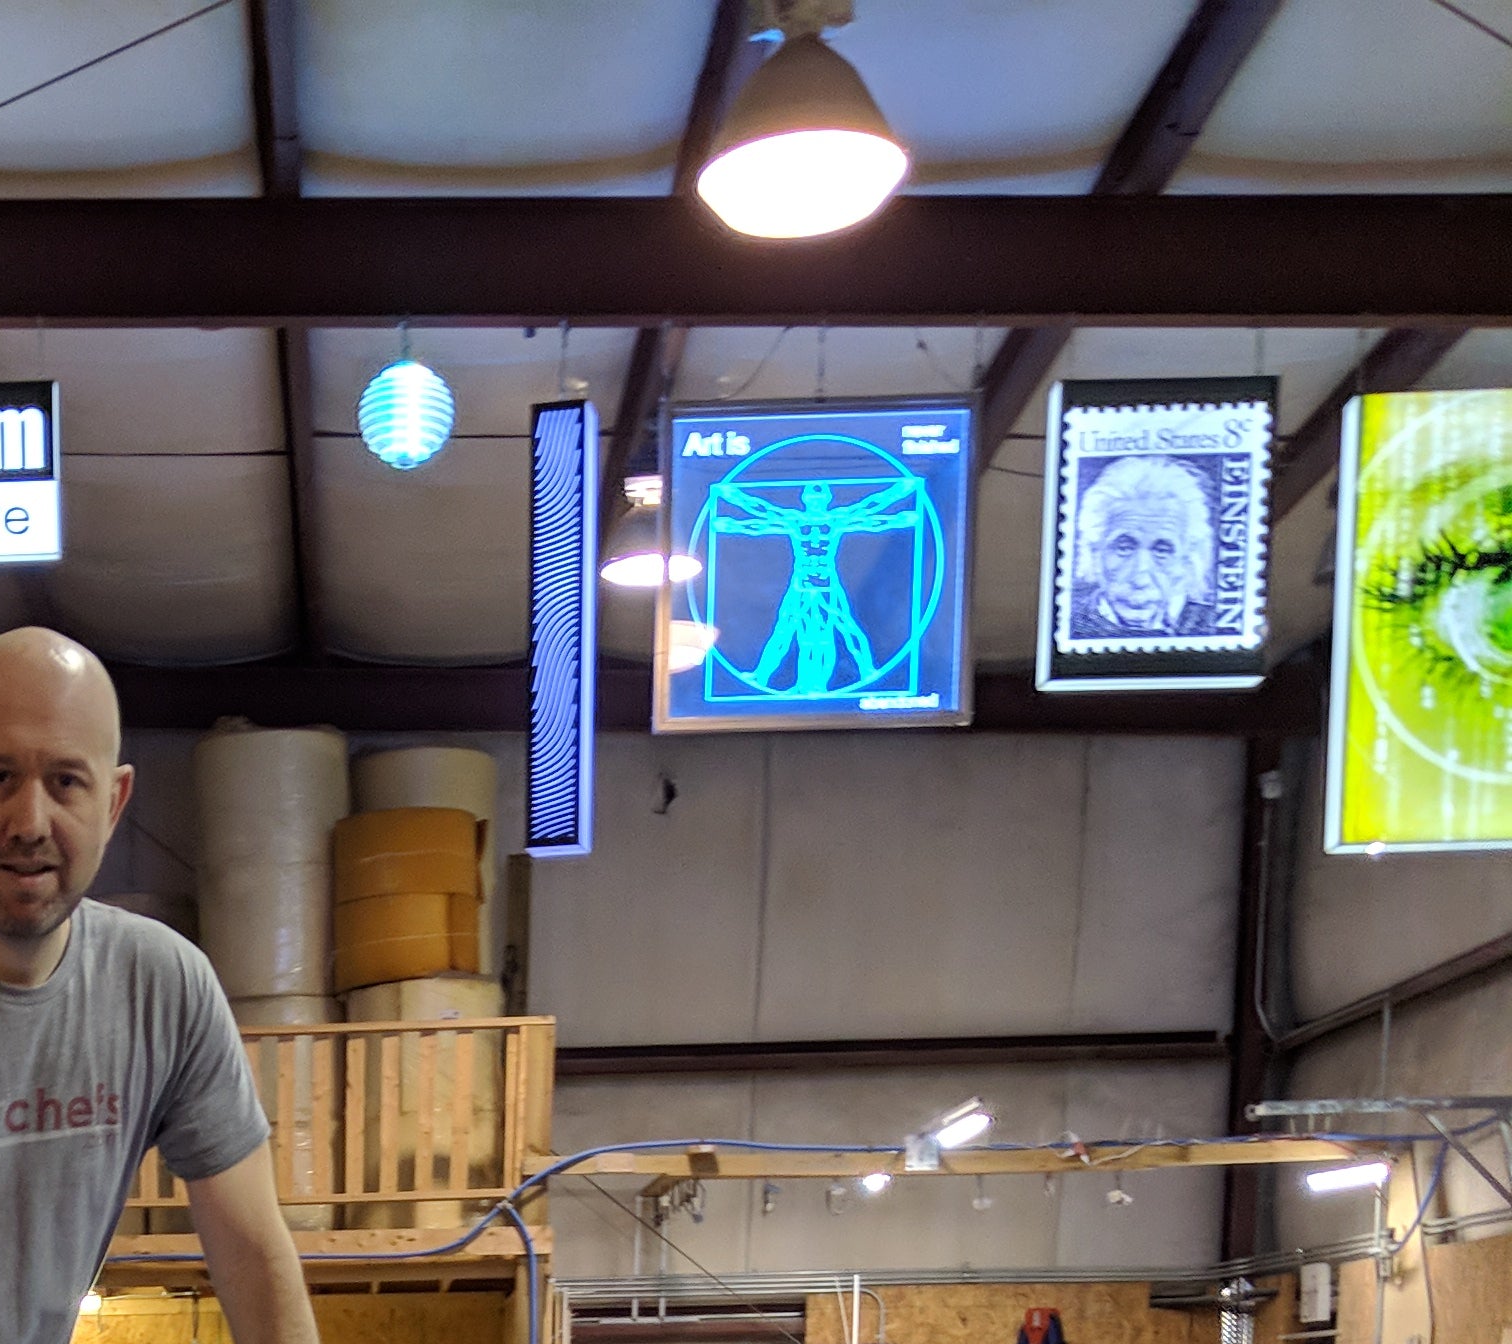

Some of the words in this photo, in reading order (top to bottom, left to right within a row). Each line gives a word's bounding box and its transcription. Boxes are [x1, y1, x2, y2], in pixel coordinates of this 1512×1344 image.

[682, 432, 724, 457] Art
[725, 430, 751, 456] is
[1079, 429, 1150, 452] United
[1155, 428, 1220, 450] States
[1215, 456, 1251, 630] EINSTEIN
